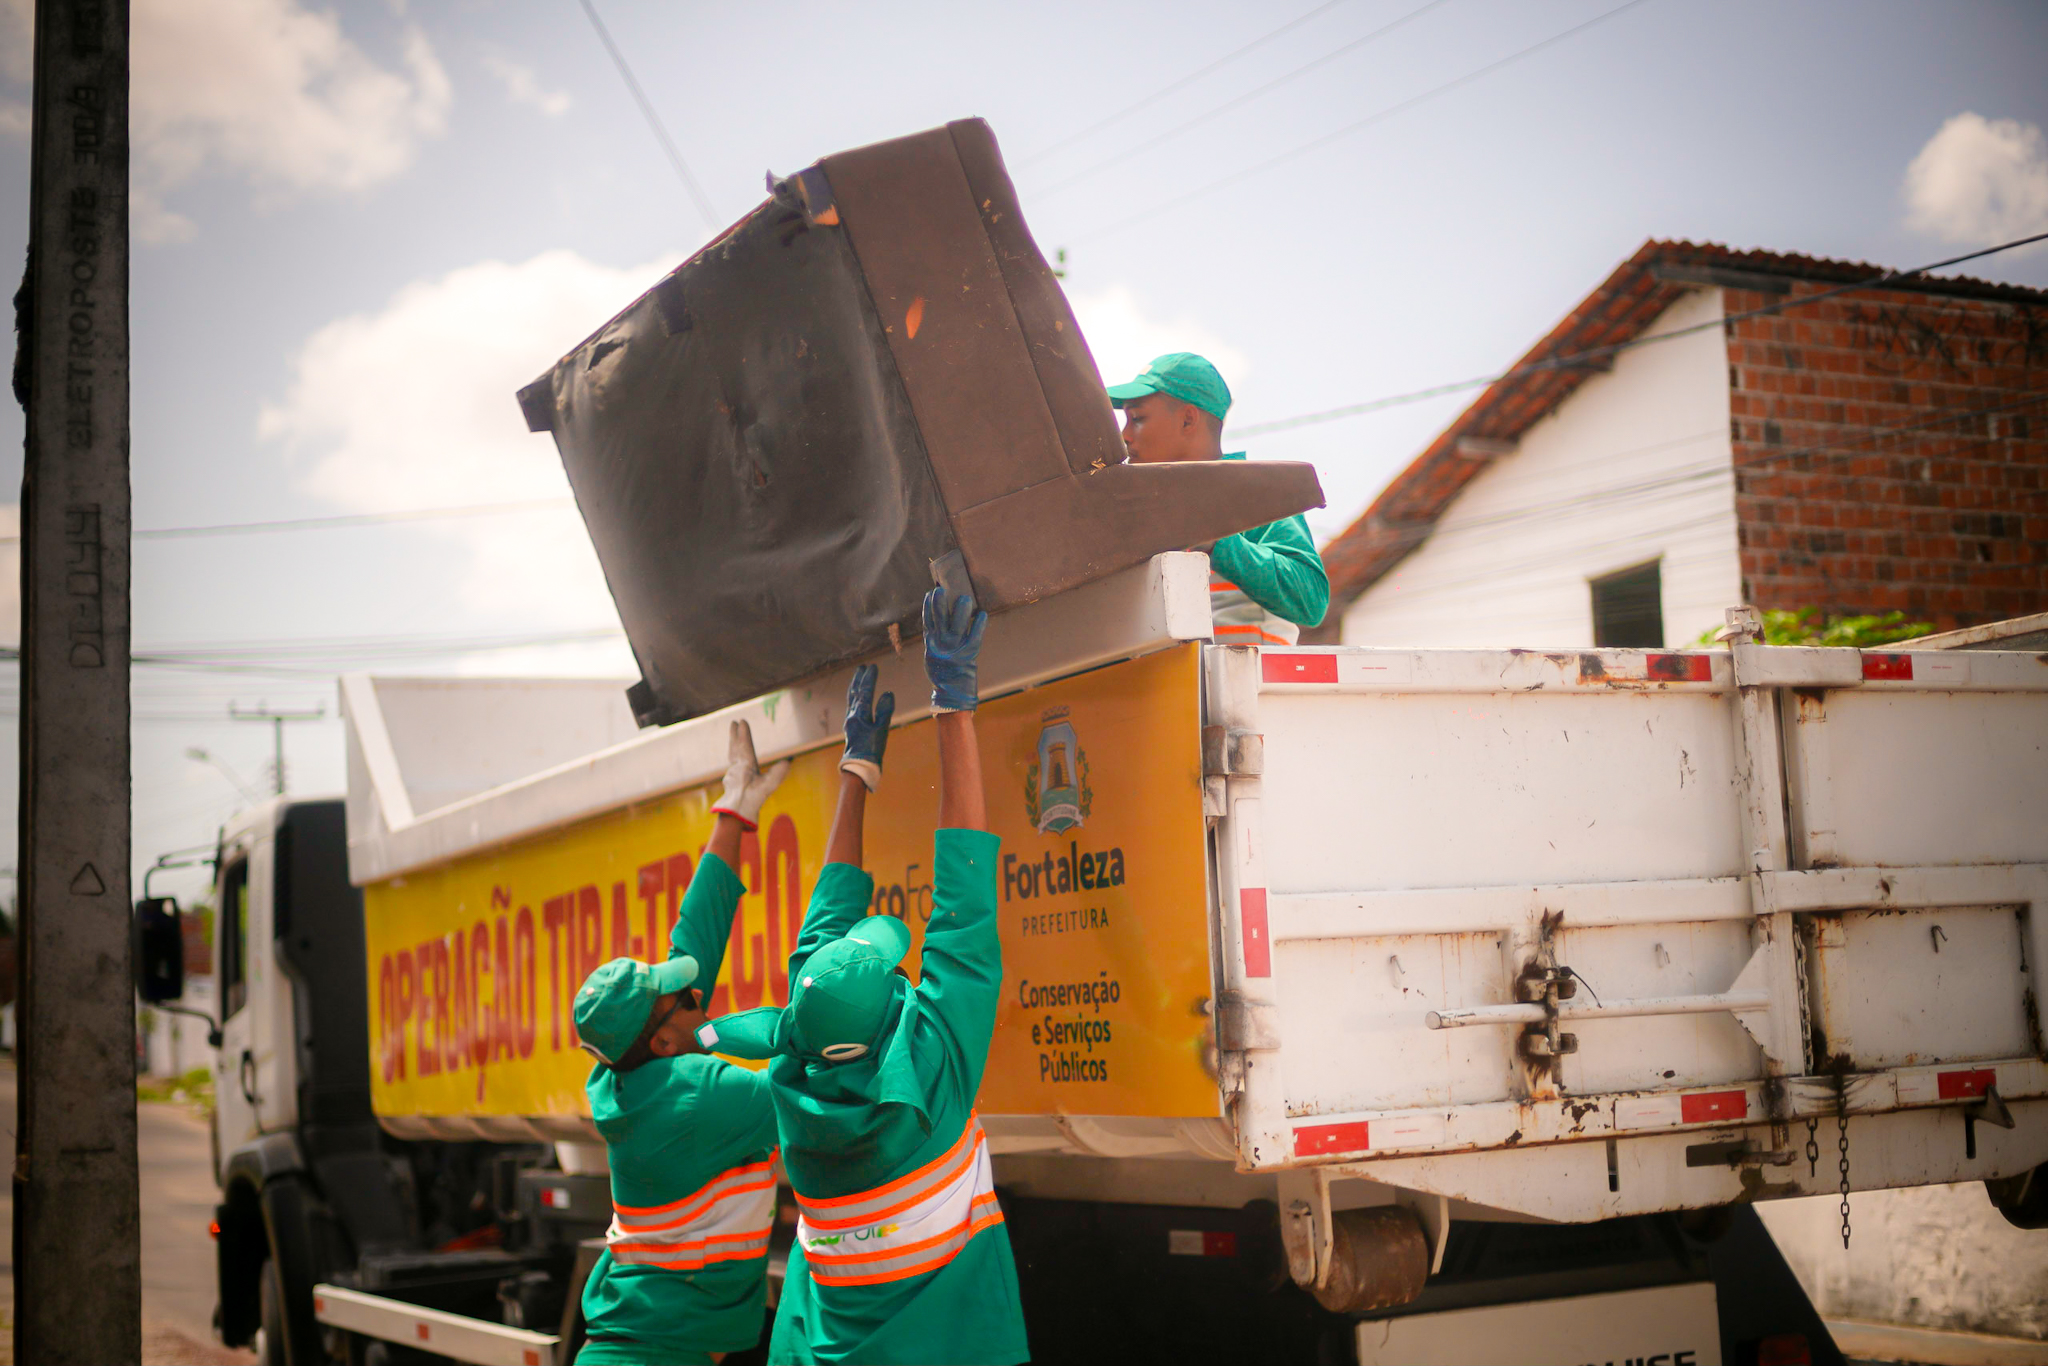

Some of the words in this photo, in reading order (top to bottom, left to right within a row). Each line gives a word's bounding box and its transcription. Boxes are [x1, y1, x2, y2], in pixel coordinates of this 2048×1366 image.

[66, 187, 98, 450] ELETROPOSTE
[1003, 840, 1125, 902] Fortaleza
[1022, 907, 1109, 937] PREFEITURA
[380, 885, 536, 1104] OPERAÇÃO
[542, 813, 800, 1052] TIR-TCO
[1020, 971, 1120, 1013] Conservação
[1032, 1024, 1041, 1045] e
[1044, 1012, 1112, 1053] Serviços
[1040, 1049, 1108, 1082] Públicos
